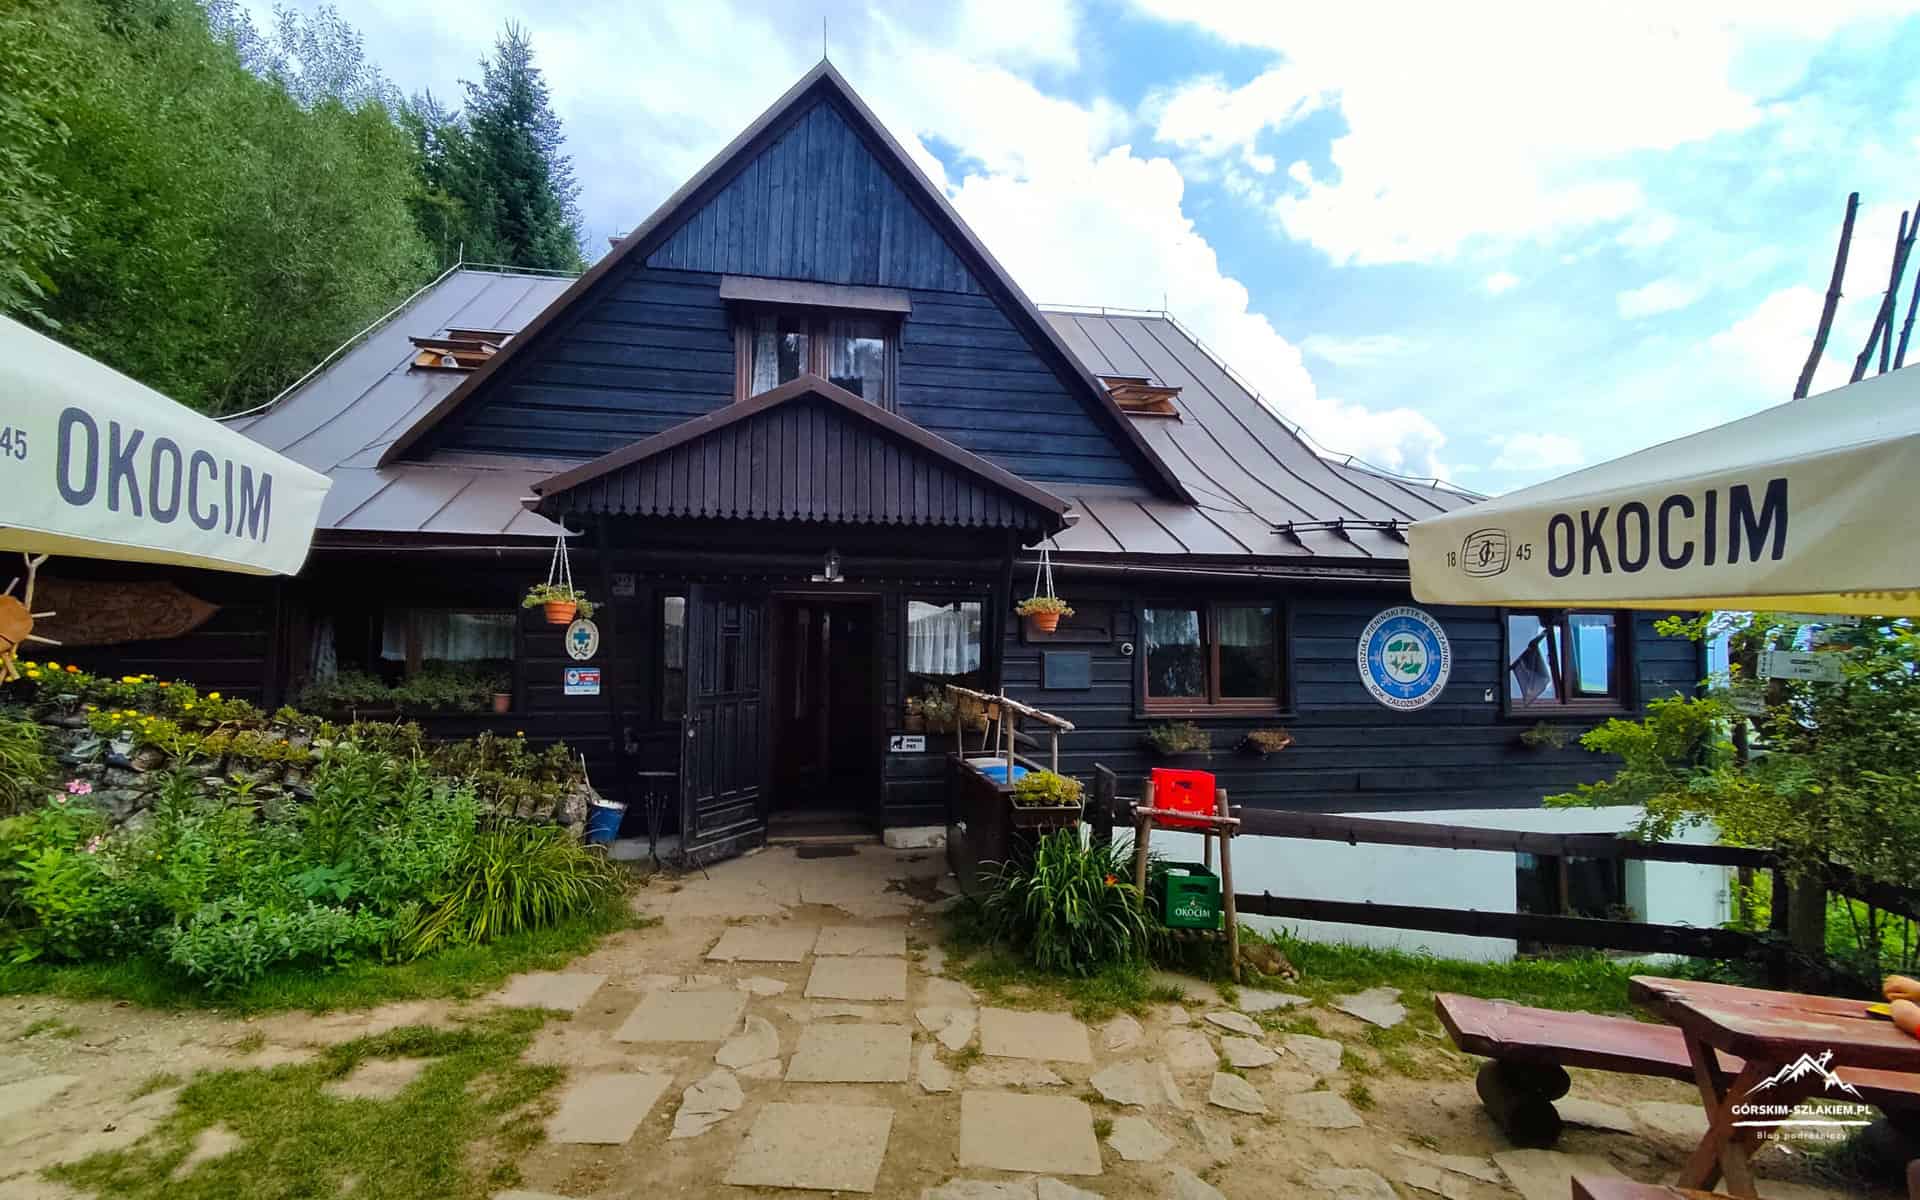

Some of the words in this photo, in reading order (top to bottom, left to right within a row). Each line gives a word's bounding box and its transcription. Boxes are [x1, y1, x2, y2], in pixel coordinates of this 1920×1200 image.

[56, 406, 273, 543] OKOCIM
[1446, 551, 1457, 568] 18
[1515, 543, 1532, 561] 45
[1547, 477, 1789, 578] OKOCIM
[1175, 907, 1210, 918] OKOCIM
